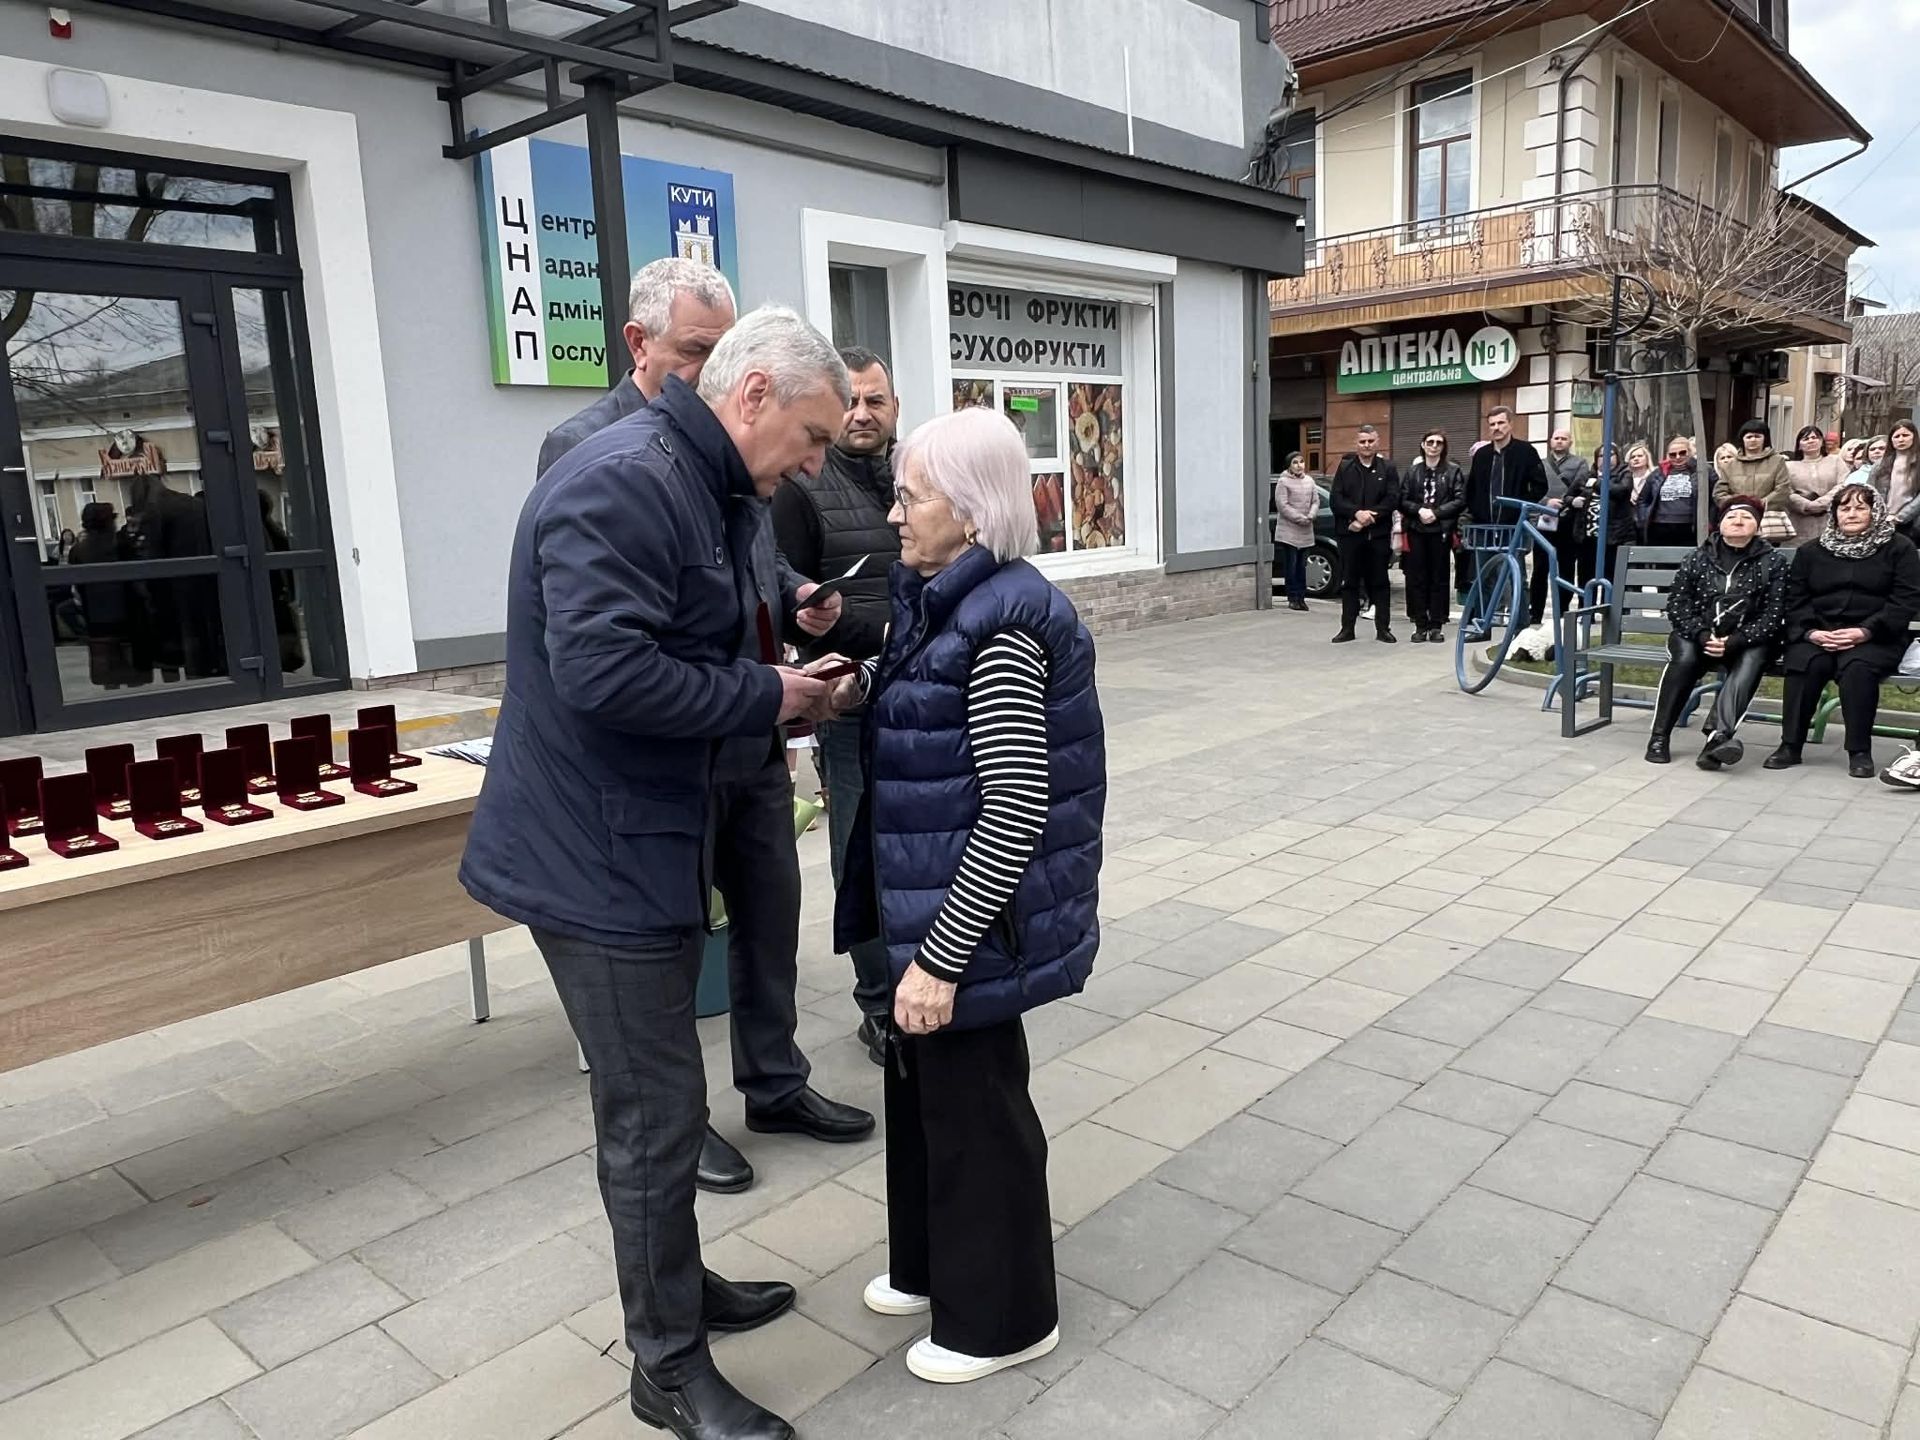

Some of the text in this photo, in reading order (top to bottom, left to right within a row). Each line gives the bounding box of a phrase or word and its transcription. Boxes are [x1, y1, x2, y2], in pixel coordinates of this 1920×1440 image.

[670, 186, 714, 207] КУТИ
[1026, 298, 1117, 331] ФРУКТИ
[950, 332, 1106, 369] СУХОФРУКТИ
[1340, 328, 1462, 376] АПТЕКА
[1392, 367, 1462, 386] центральна
